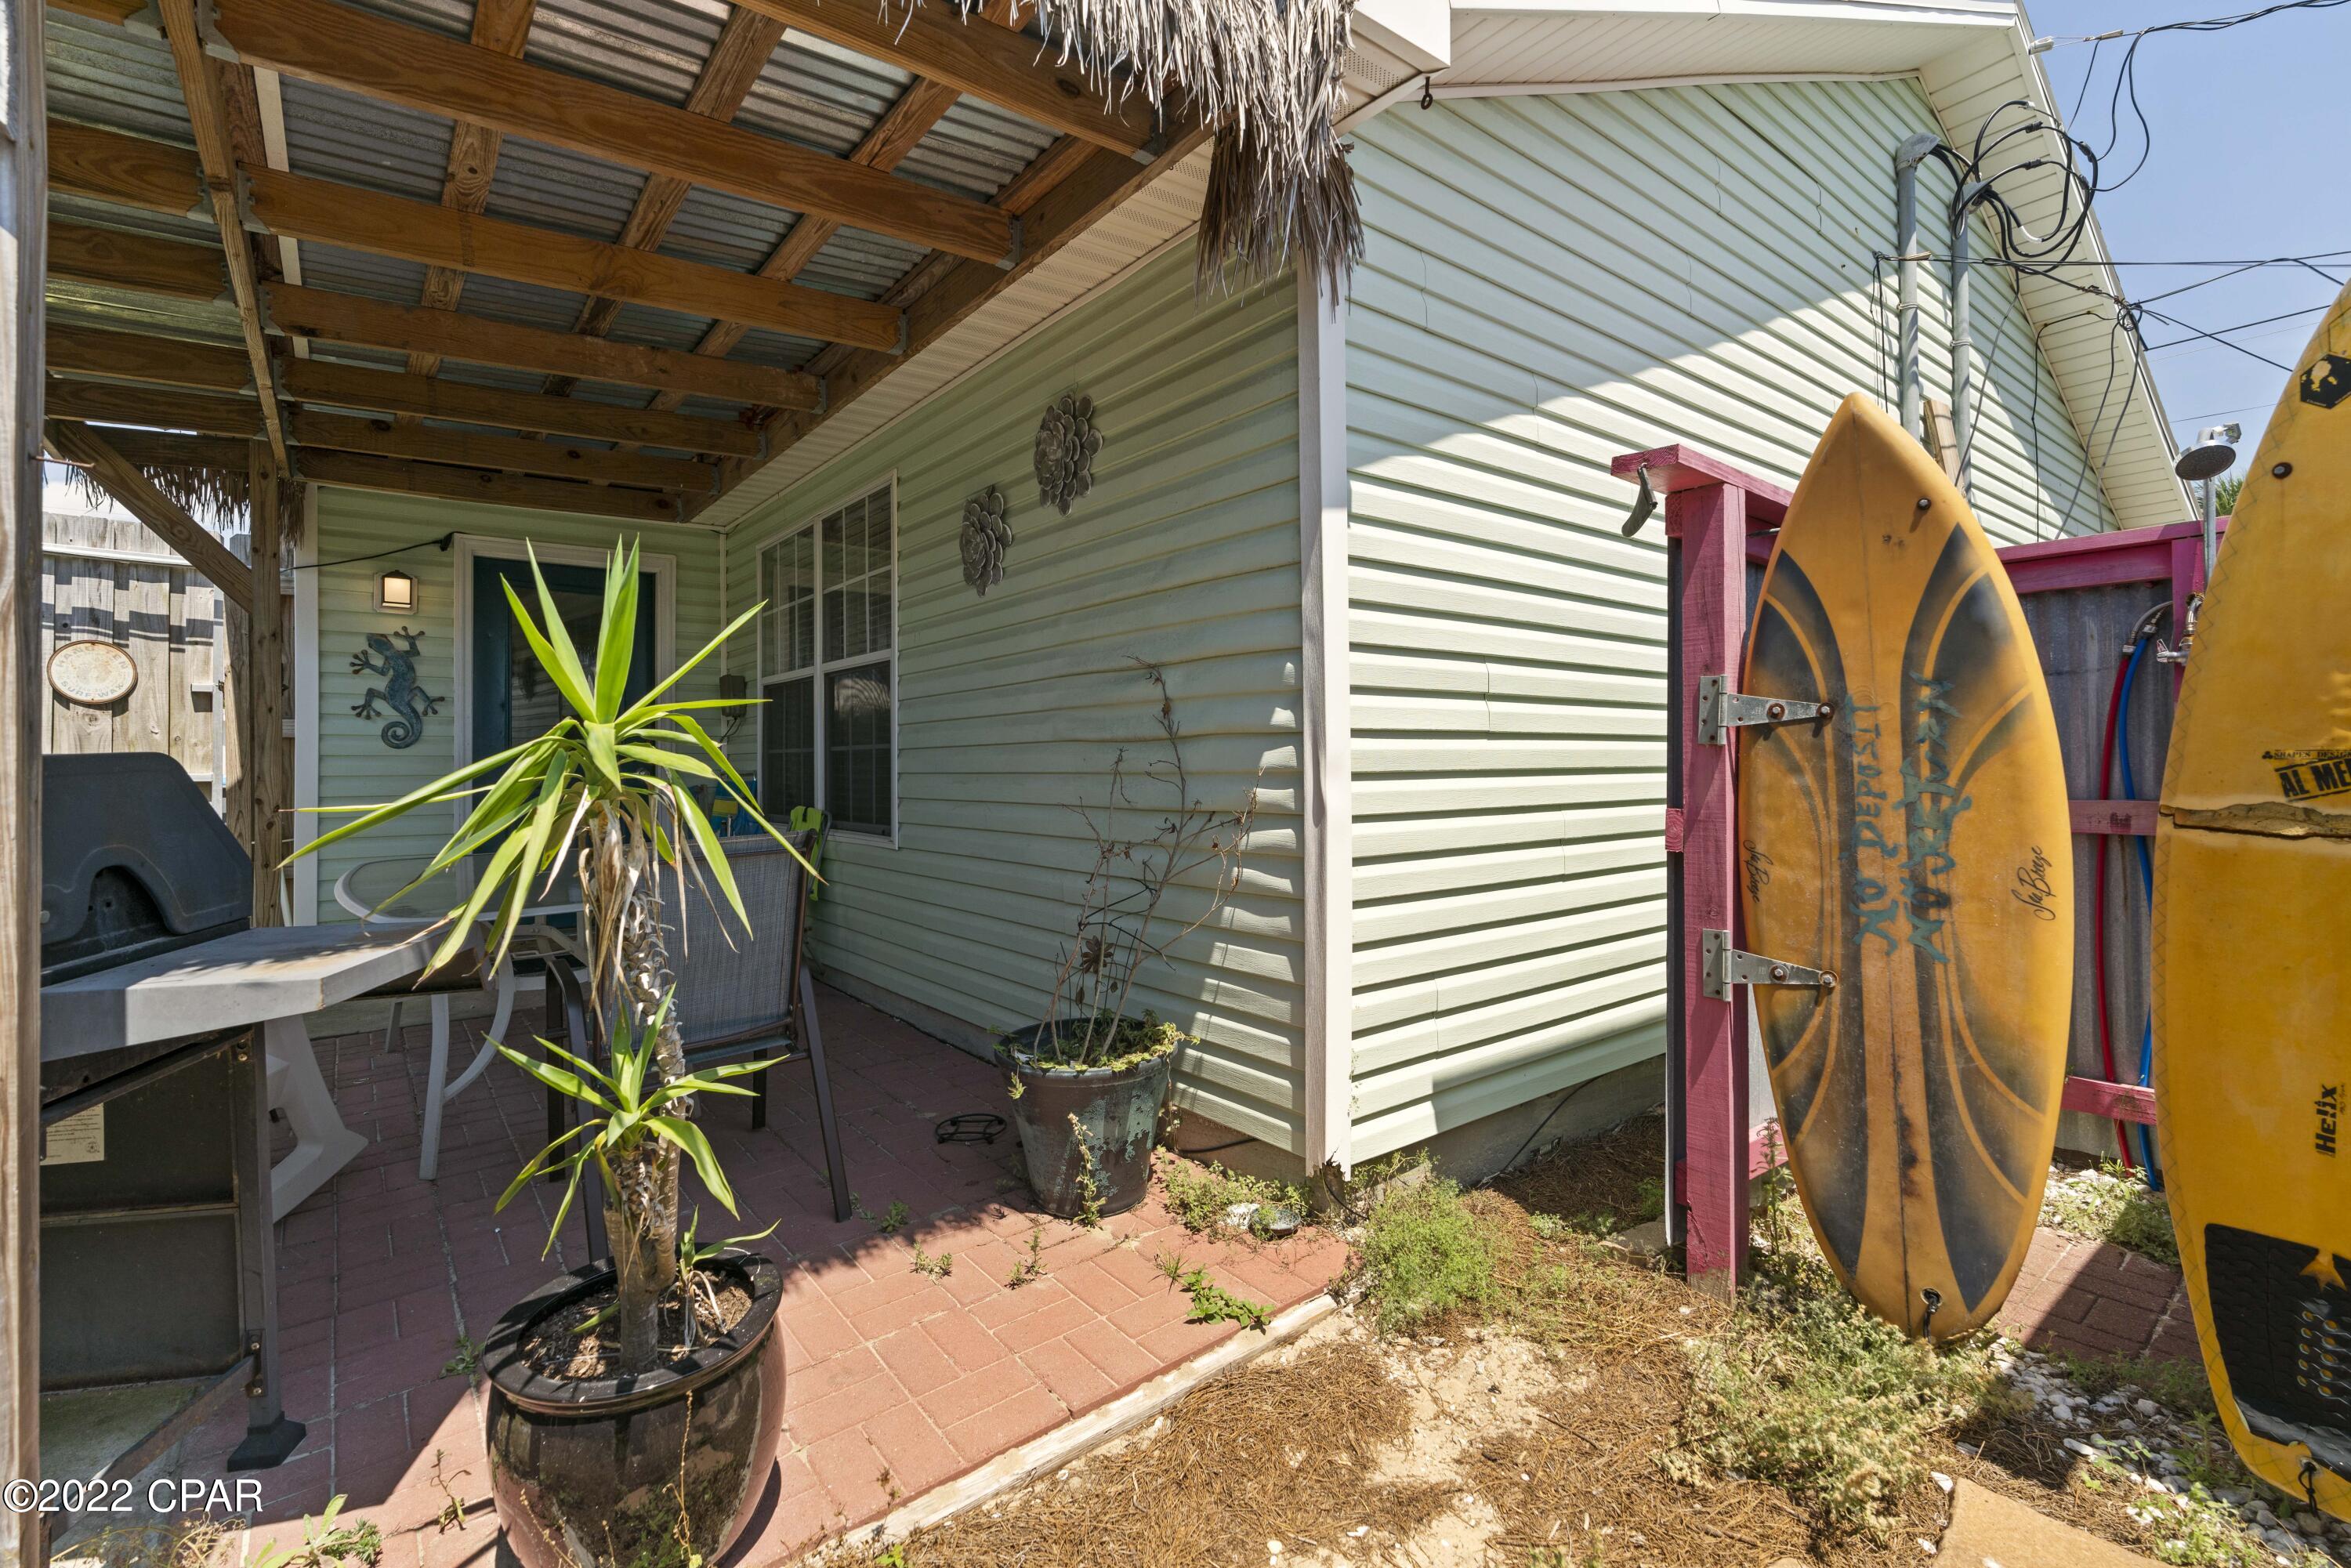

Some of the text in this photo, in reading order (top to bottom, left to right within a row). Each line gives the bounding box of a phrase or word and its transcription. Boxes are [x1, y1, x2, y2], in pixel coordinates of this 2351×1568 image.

[61, 680, 92, 697] SURF
[97, 683, 124, 697] WAX
[2279, 770, 2310, 798] AL
[1839, 693, 1899, 956] NO DEPOSIT
[1900, 876, 1951, 963] NO
[2314, 1084, 2337, 1158] Helix
